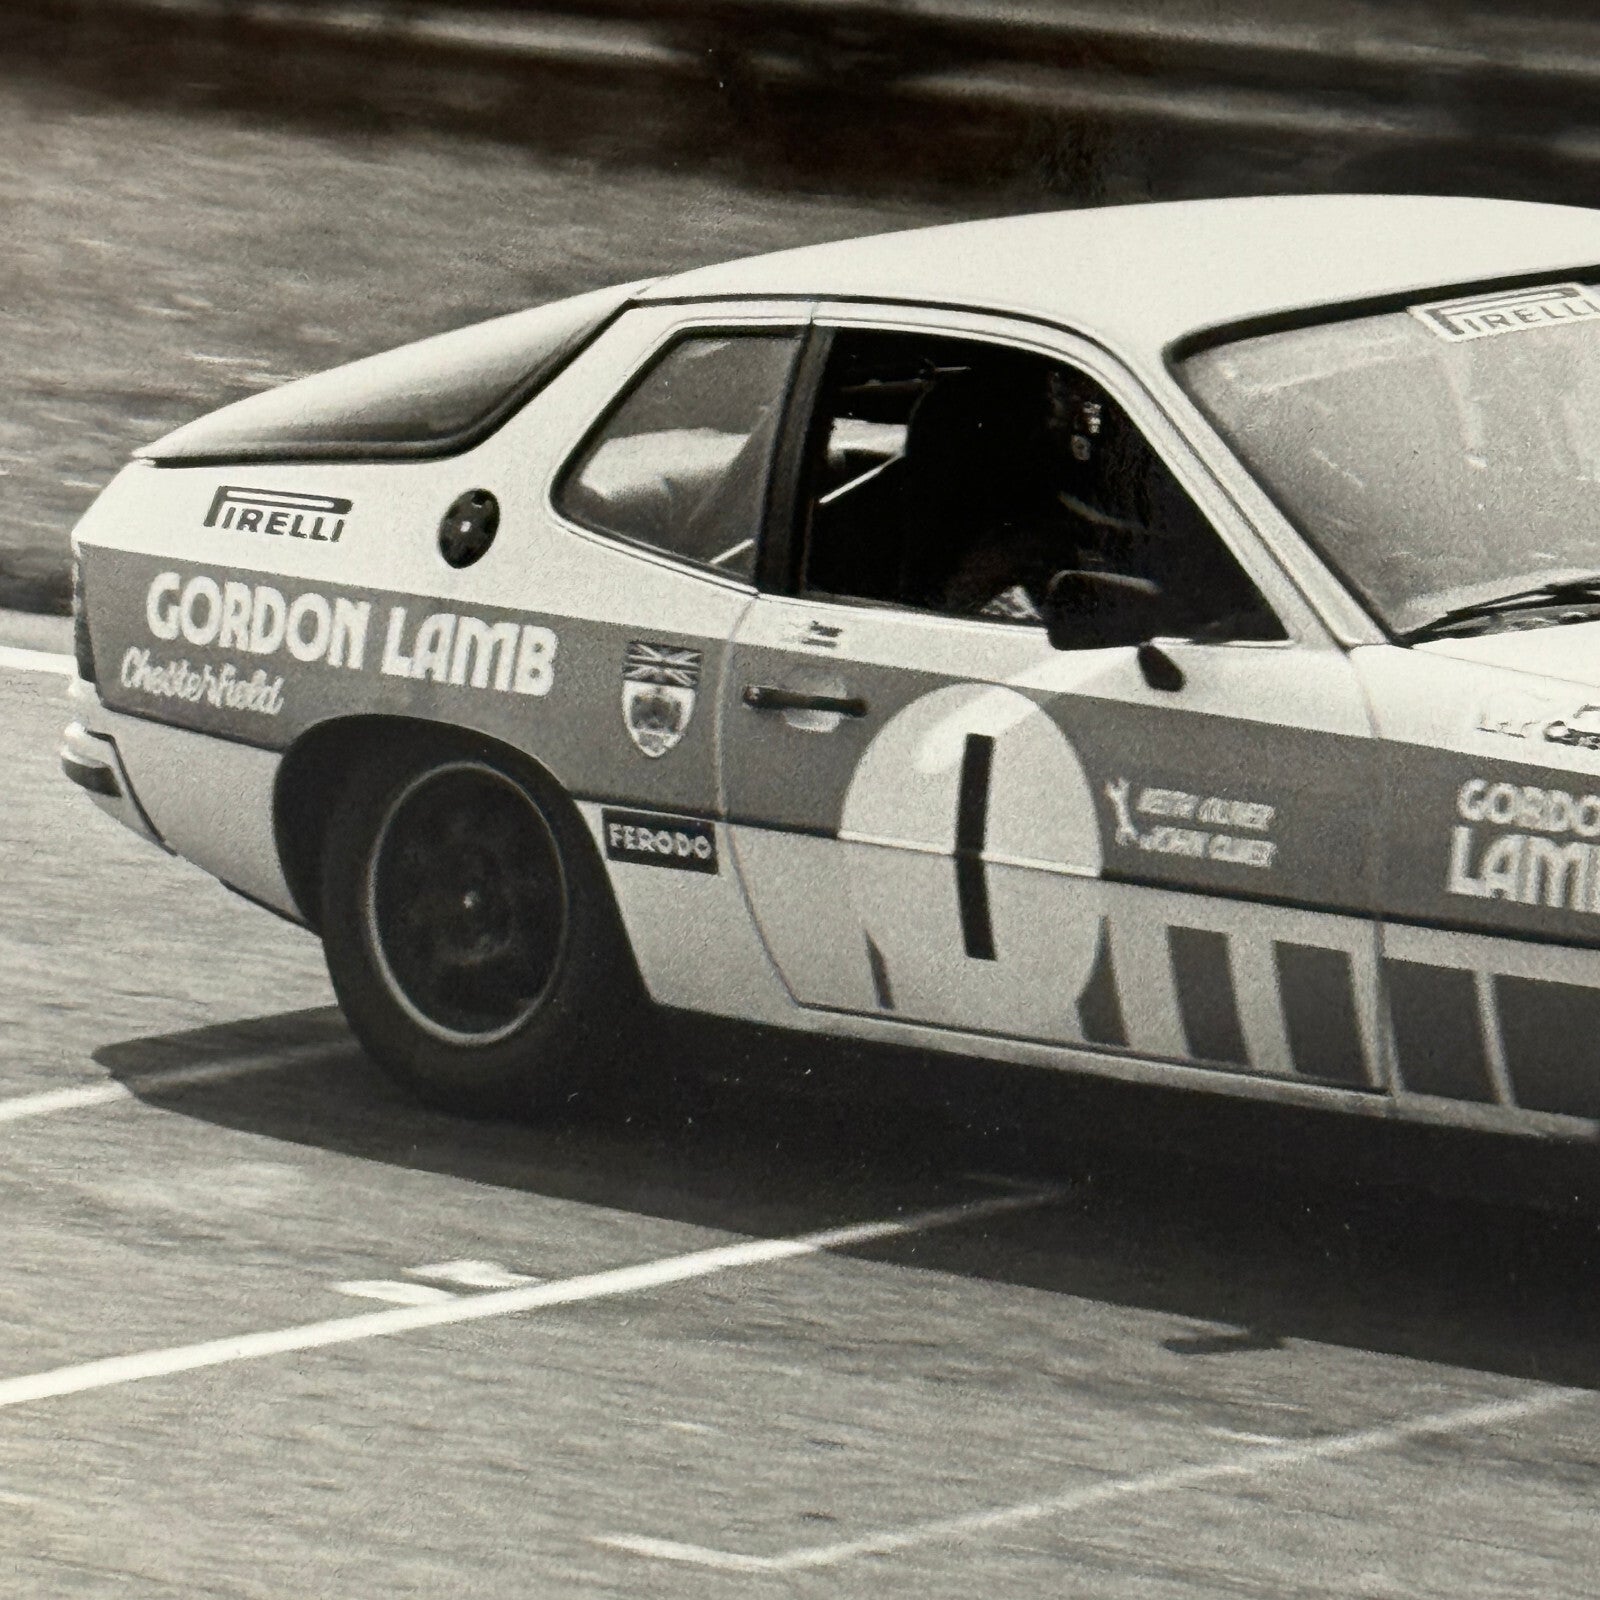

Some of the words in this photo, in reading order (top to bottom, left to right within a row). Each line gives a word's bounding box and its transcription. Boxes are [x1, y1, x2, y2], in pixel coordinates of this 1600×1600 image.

[1425, 287, 1600, 335] PIRELLI
[203, 485, 353, 542] PIRELLI
[146, 571, 371, 670] GORDON
[380, 606, 559, 697] LAMB
[121, 646, 284, 715] Chesterfield
[609, 823, 713, 860] FERODO
[954, 733, 998, 961] 1
[1448, 825, 1600, 915] LAM
